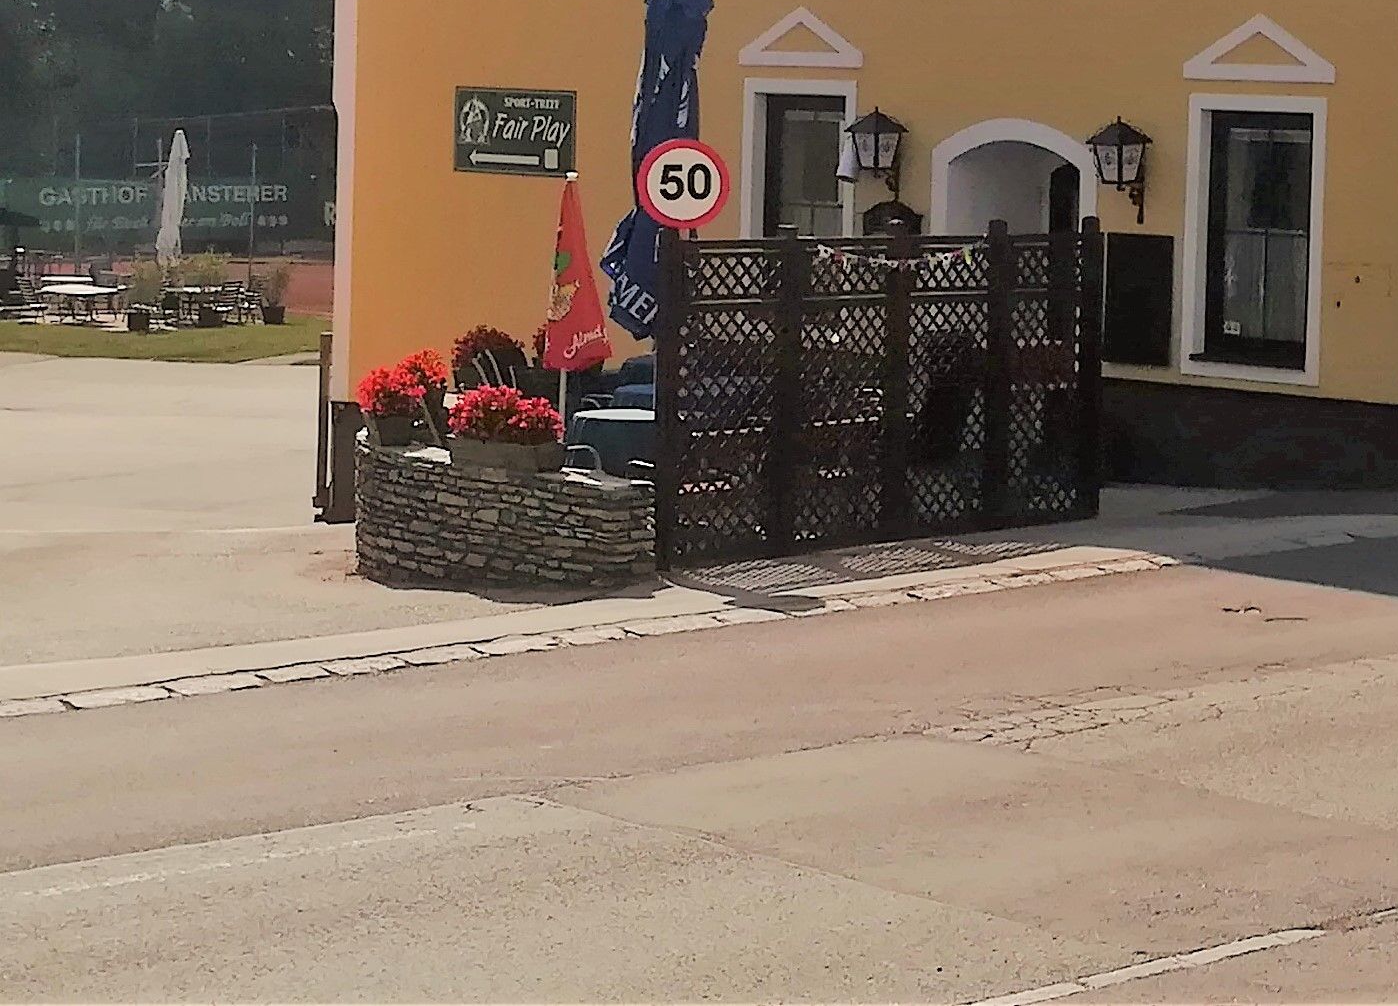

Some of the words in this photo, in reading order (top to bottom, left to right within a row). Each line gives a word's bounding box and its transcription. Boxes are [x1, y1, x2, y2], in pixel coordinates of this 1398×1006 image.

[492, 112, 529, 140] Fair
[530, 115, 571, 148] Play
[659, 163, 712, 201] 50
